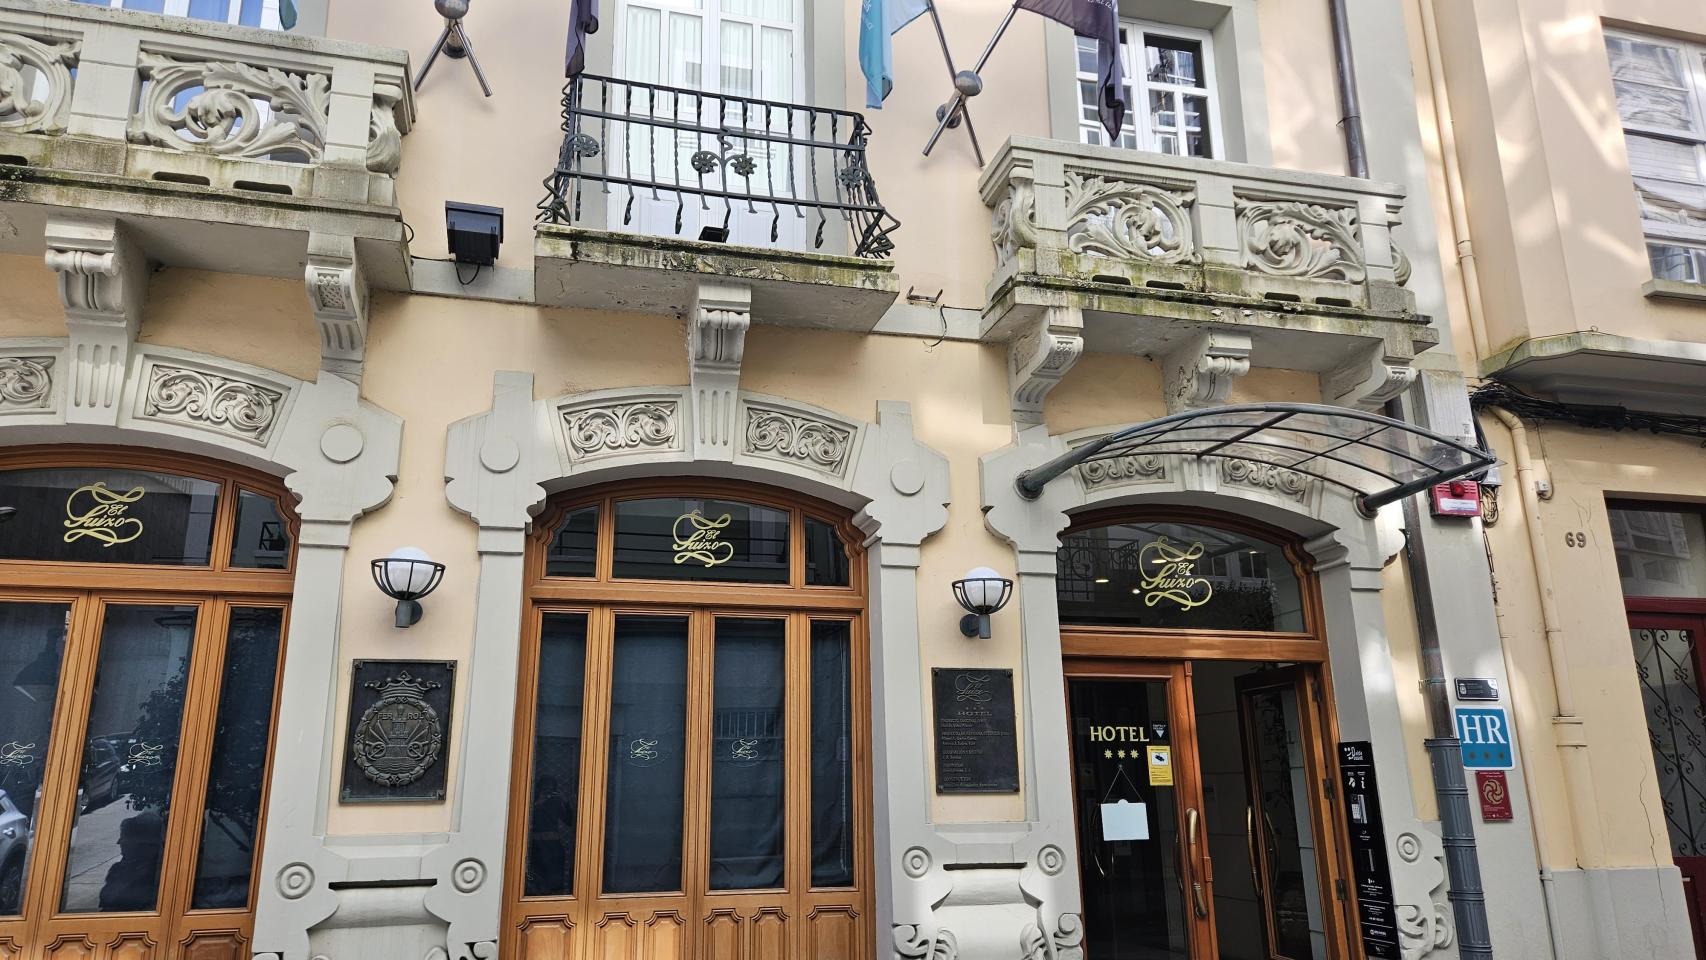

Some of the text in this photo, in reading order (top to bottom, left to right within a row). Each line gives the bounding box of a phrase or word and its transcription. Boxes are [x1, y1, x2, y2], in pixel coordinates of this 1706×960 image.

[107, 504, 128, 516] El
[705, 530, 721, 540] El
[1565, 532, 1586, 548] 69
[1177, 562, 1195, 576] El
[1090, 725, 1150, 742] HOTEL
[1458, 714, 1508, 744] HR
